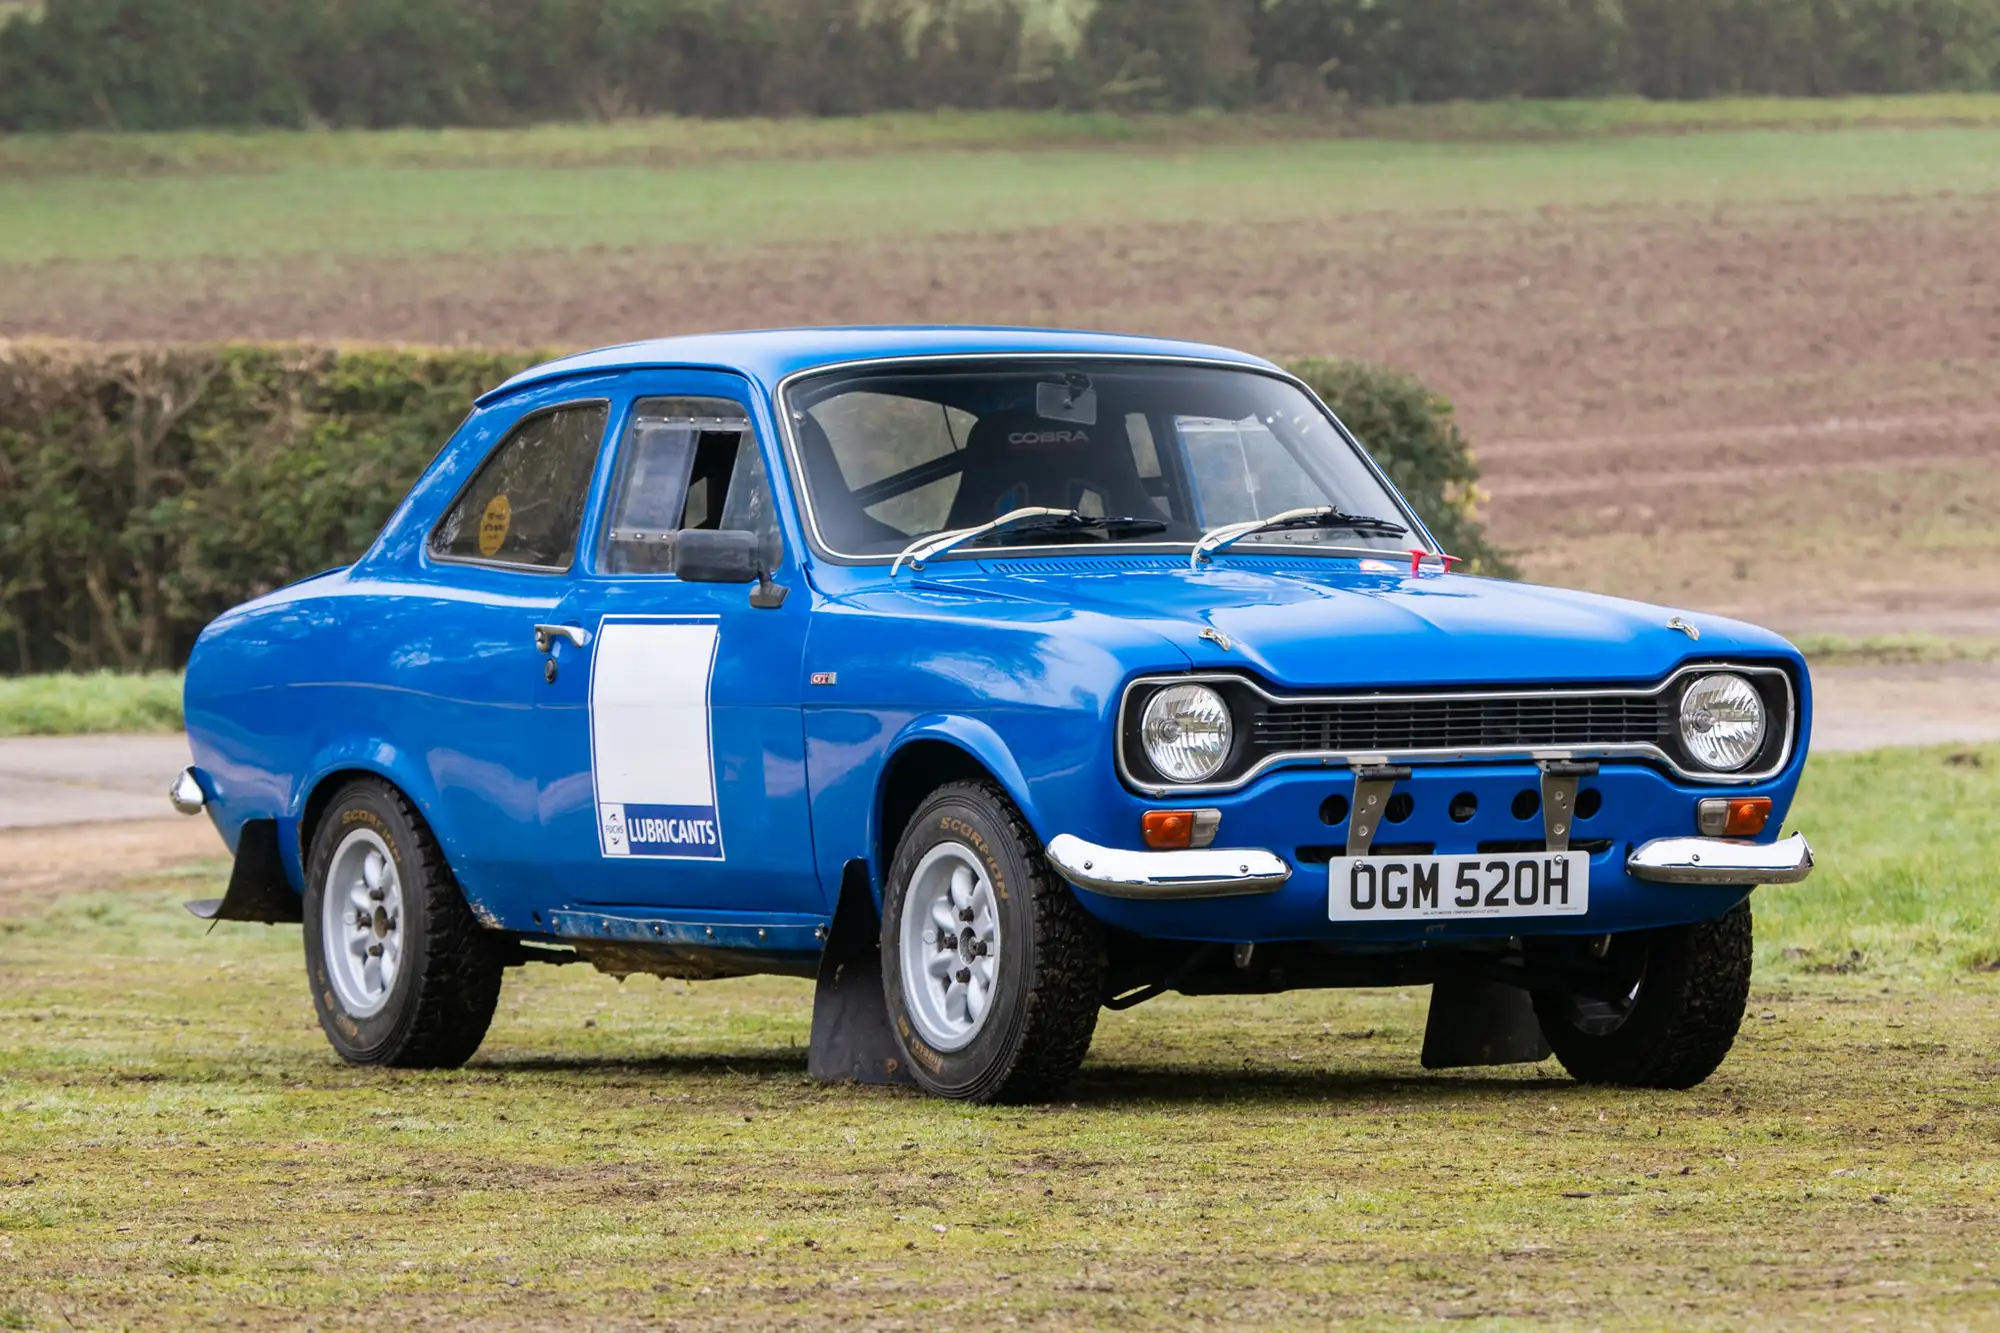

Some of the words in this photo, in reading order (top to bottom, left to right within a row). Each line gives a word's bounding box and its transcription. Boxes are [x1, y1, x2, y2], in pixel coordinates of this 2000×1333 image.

[1008, 430, 1089, 444] COBRA
[605, 825, 624, 834] FUCHS
[628, 818, 717, 845] LUBRICANTS
[940, 817, 1008, 899] SCORPION
[1350, 863, 1439, 910] OGM
[1454, 859, 1570, 907] 520H
